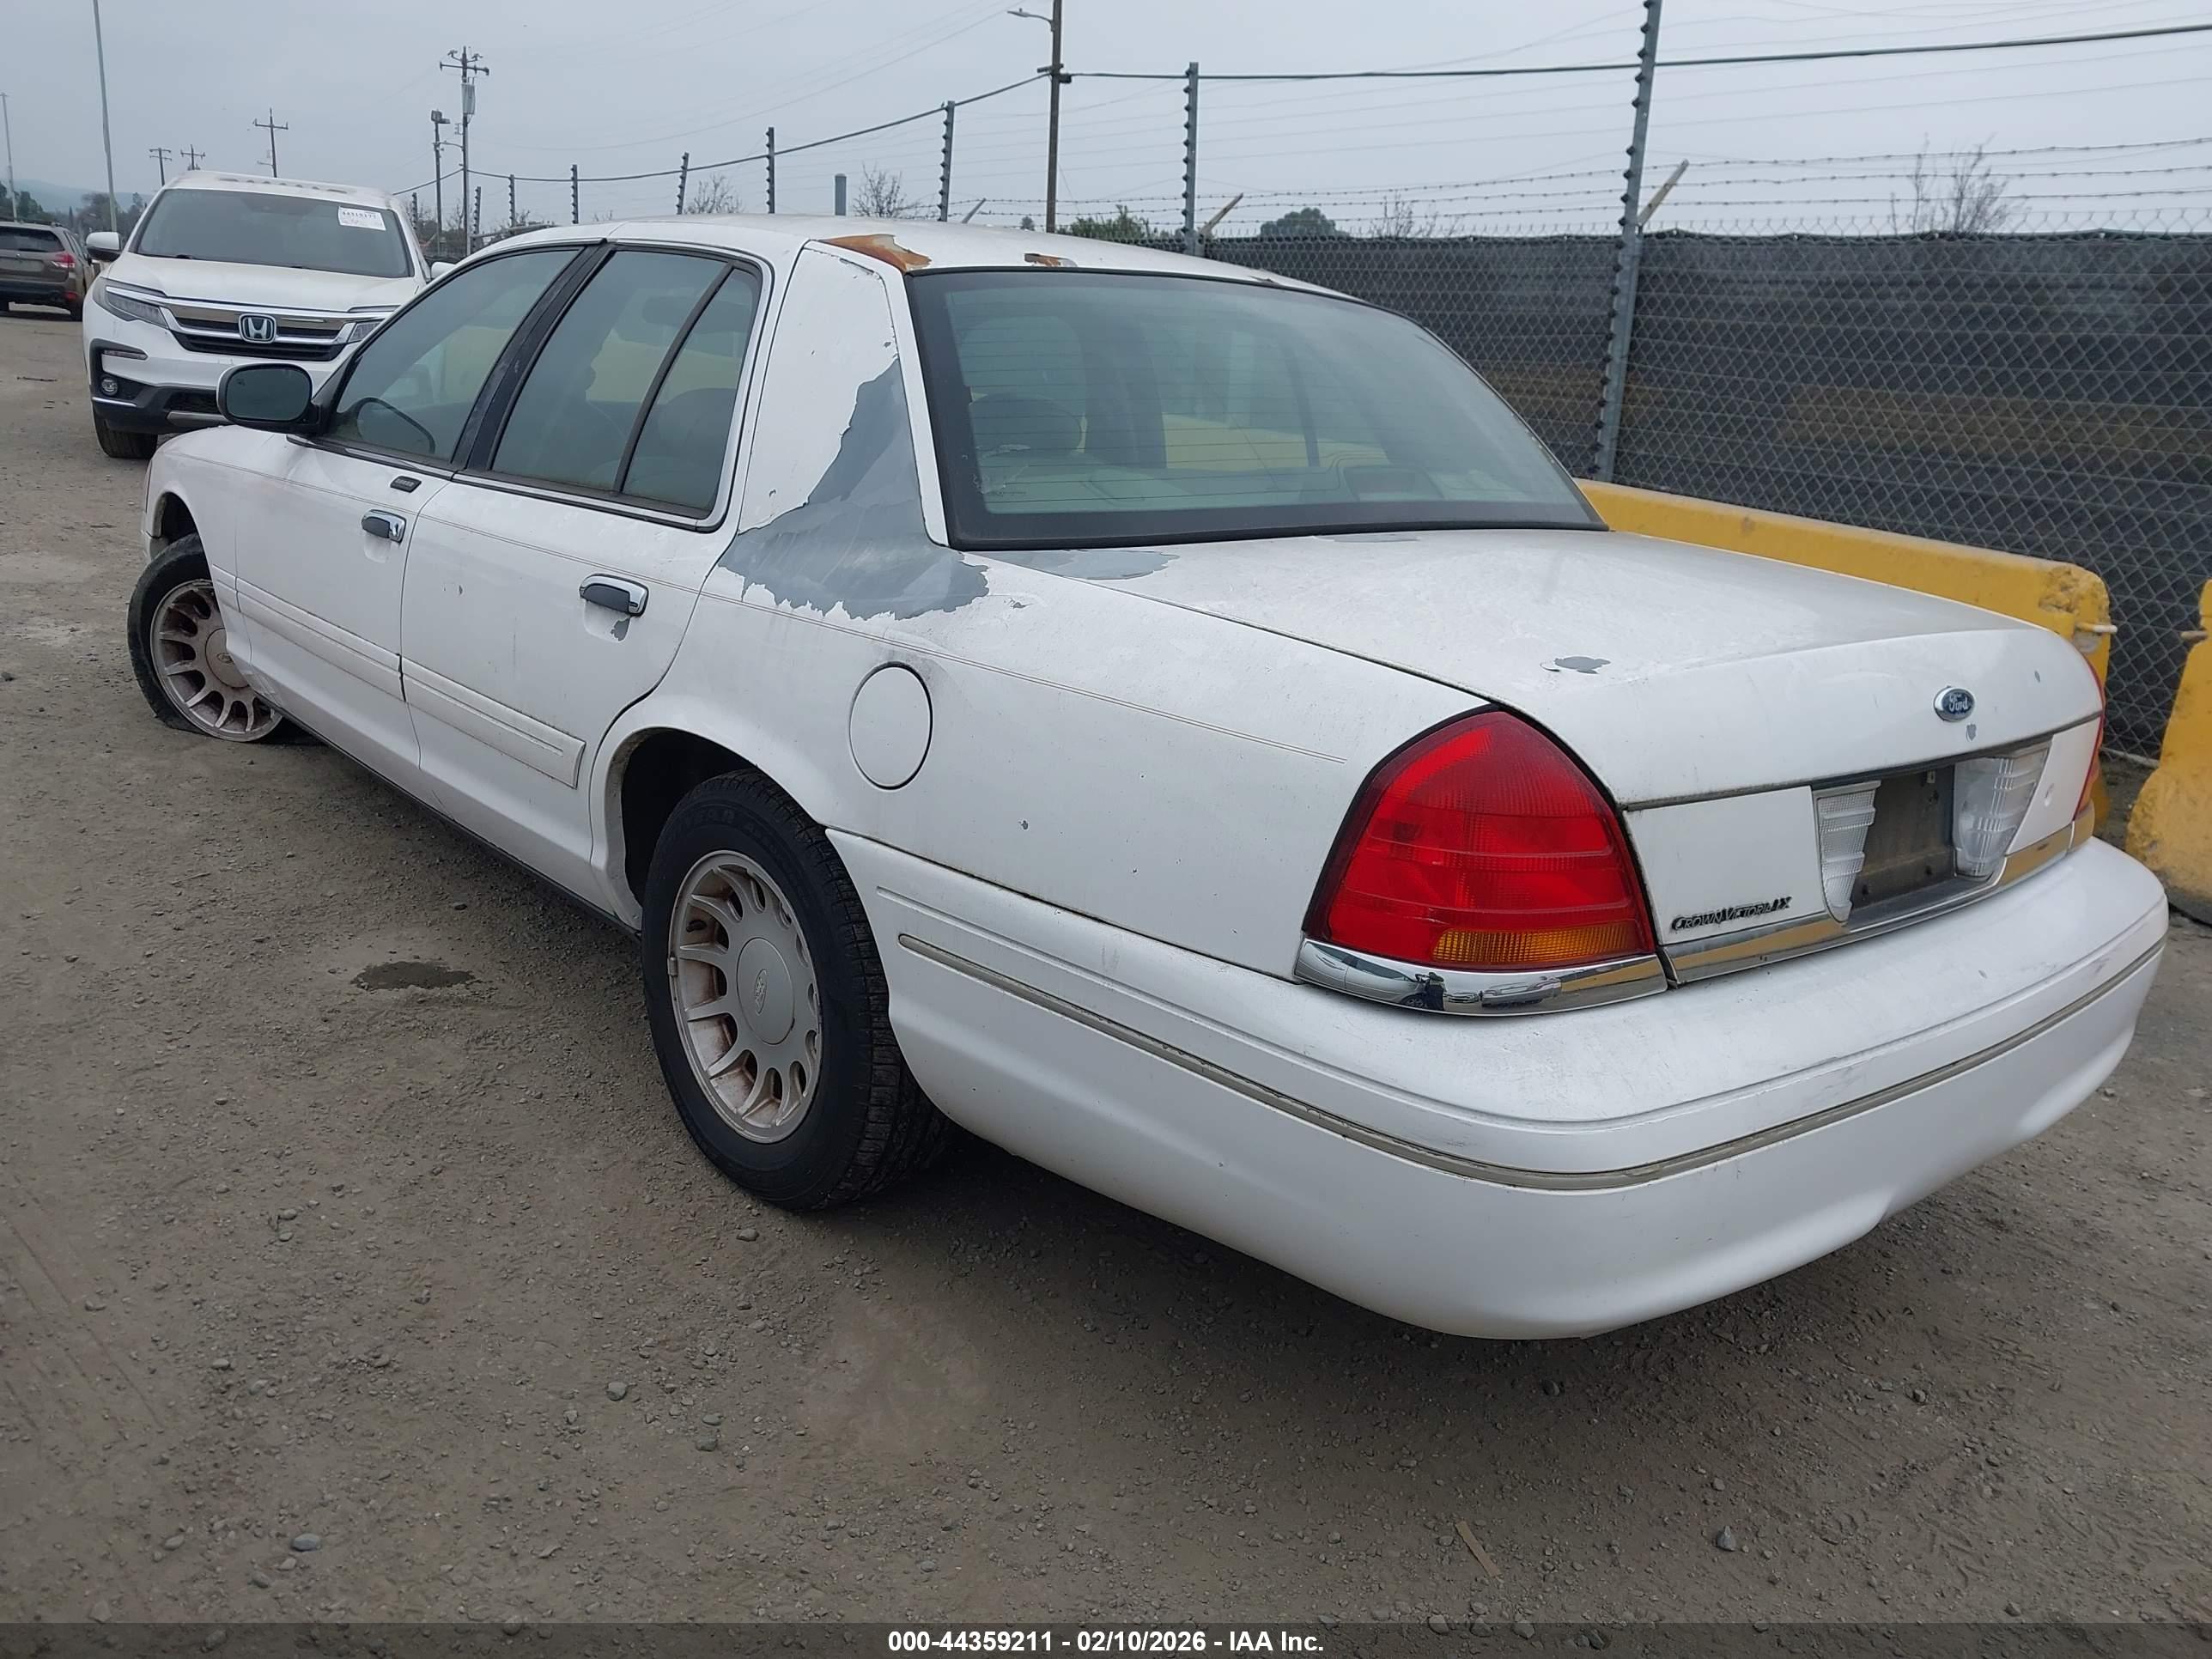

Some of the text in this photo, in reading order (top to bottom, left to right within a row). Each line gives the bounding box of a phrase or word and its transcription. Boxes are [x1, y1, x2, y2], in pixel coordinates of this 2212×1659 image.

[1948, 693, 1969, 712] Ford
[1671, 912, 1723, 930] CROWN
[1722, 902, 1771, 921] VICTORIA
